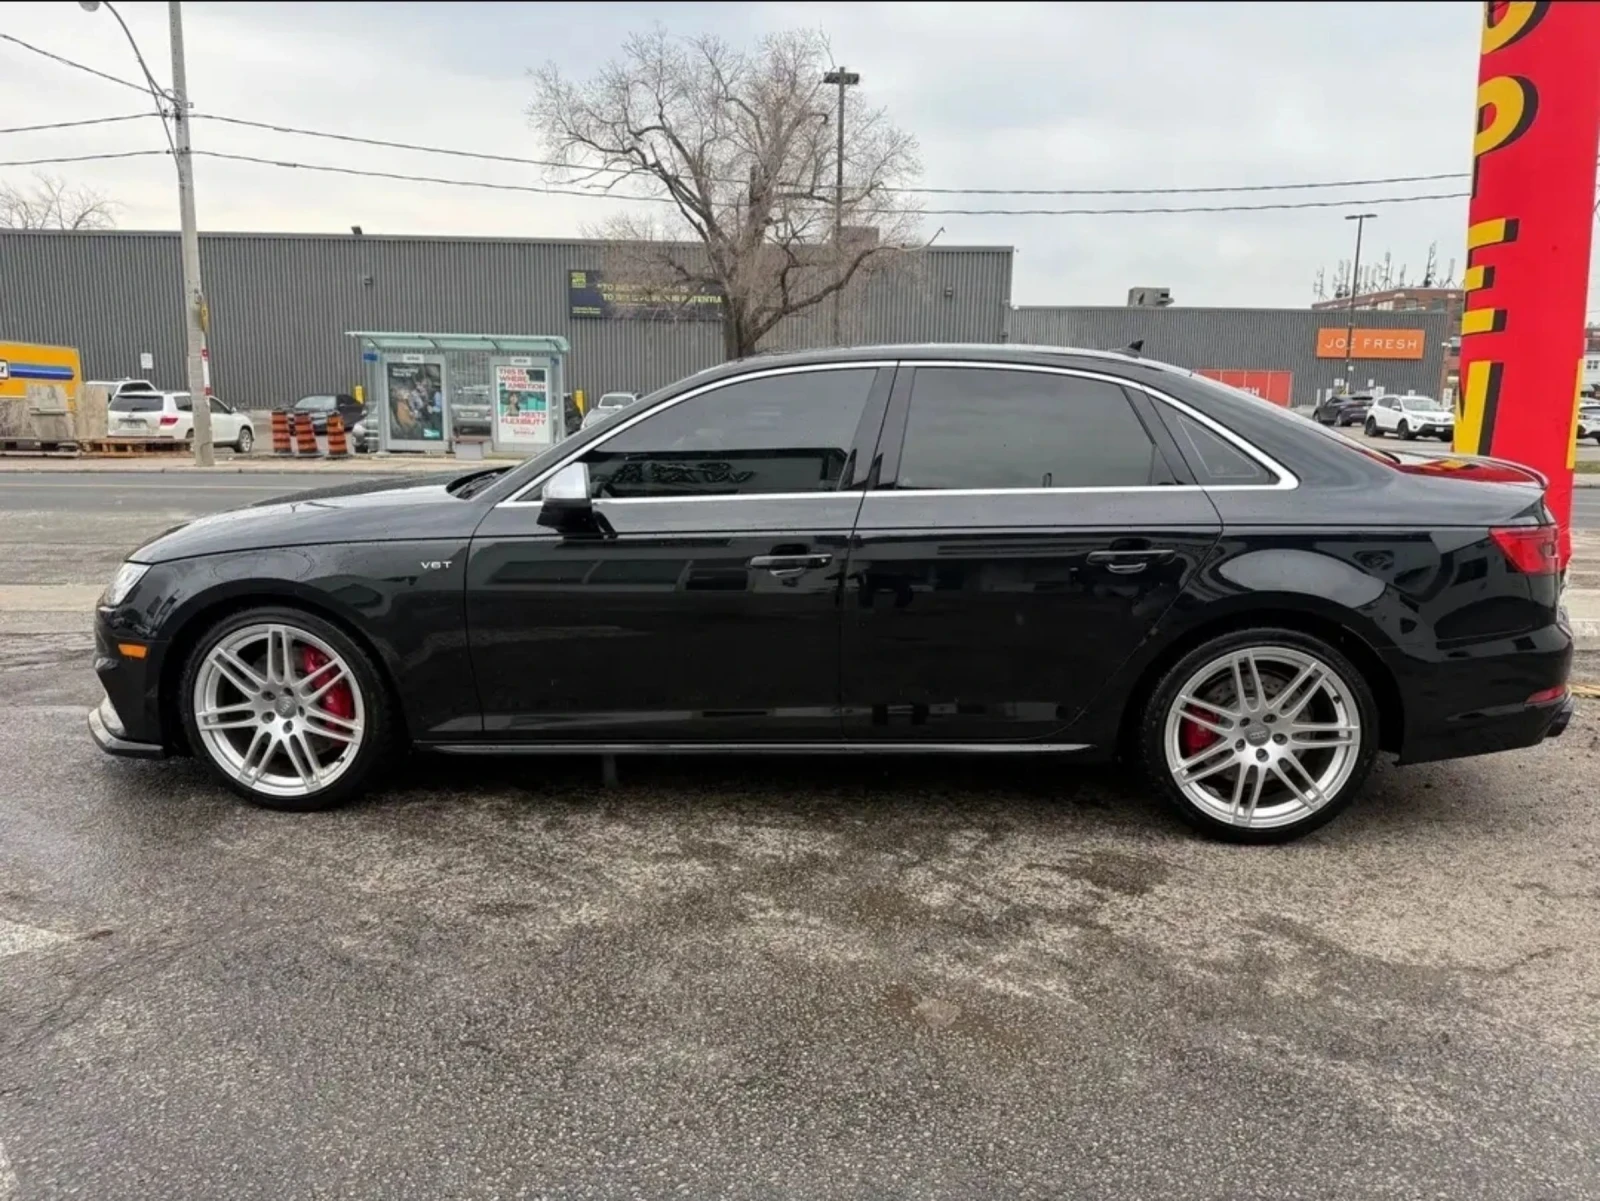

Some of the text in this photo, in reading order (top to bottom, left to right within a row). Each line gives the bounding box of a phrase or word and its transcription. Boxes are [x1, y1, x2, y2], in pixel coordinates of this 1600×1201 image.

[1363, 338, 1418, 350] FRESH
[507, 382, 546, 390] AMBITION
[420, 561, 452, 569] V6T
